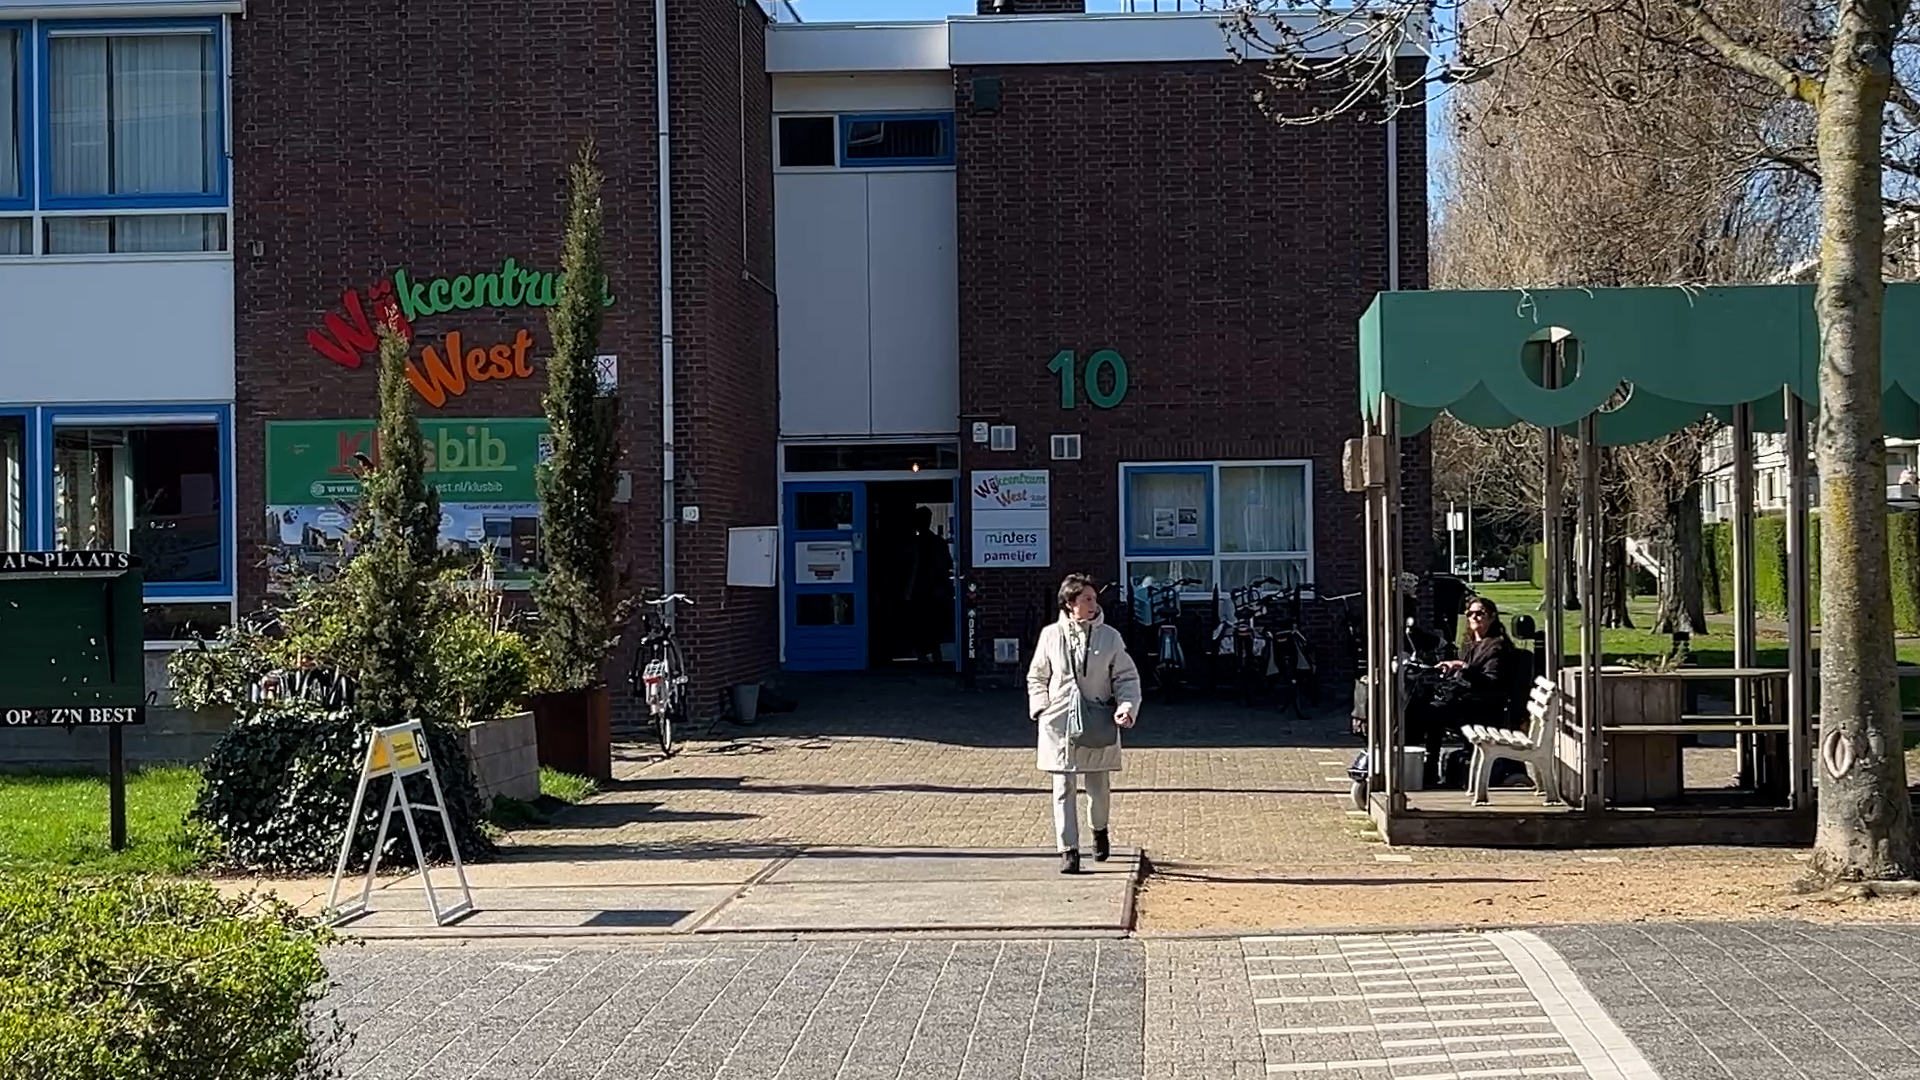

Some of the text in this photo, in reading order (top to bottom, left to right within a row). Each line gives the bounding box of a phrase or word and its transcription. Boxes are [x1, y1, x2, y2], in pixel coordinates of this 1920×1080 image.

[404, 329, 534, 408] West
[1047, 349, 1129, 409] 10
[334, 427, 508, 474] Klsbib
[995, 489, 1028, 507] West
[985, 531, 1037, 544] minters
[44, 552, 129, 568] PLAATS
[983, 550, 1037, 563] pameijer
[968, 618, 976, 659] OPEN
[89, 707, 137, 723] BEST
